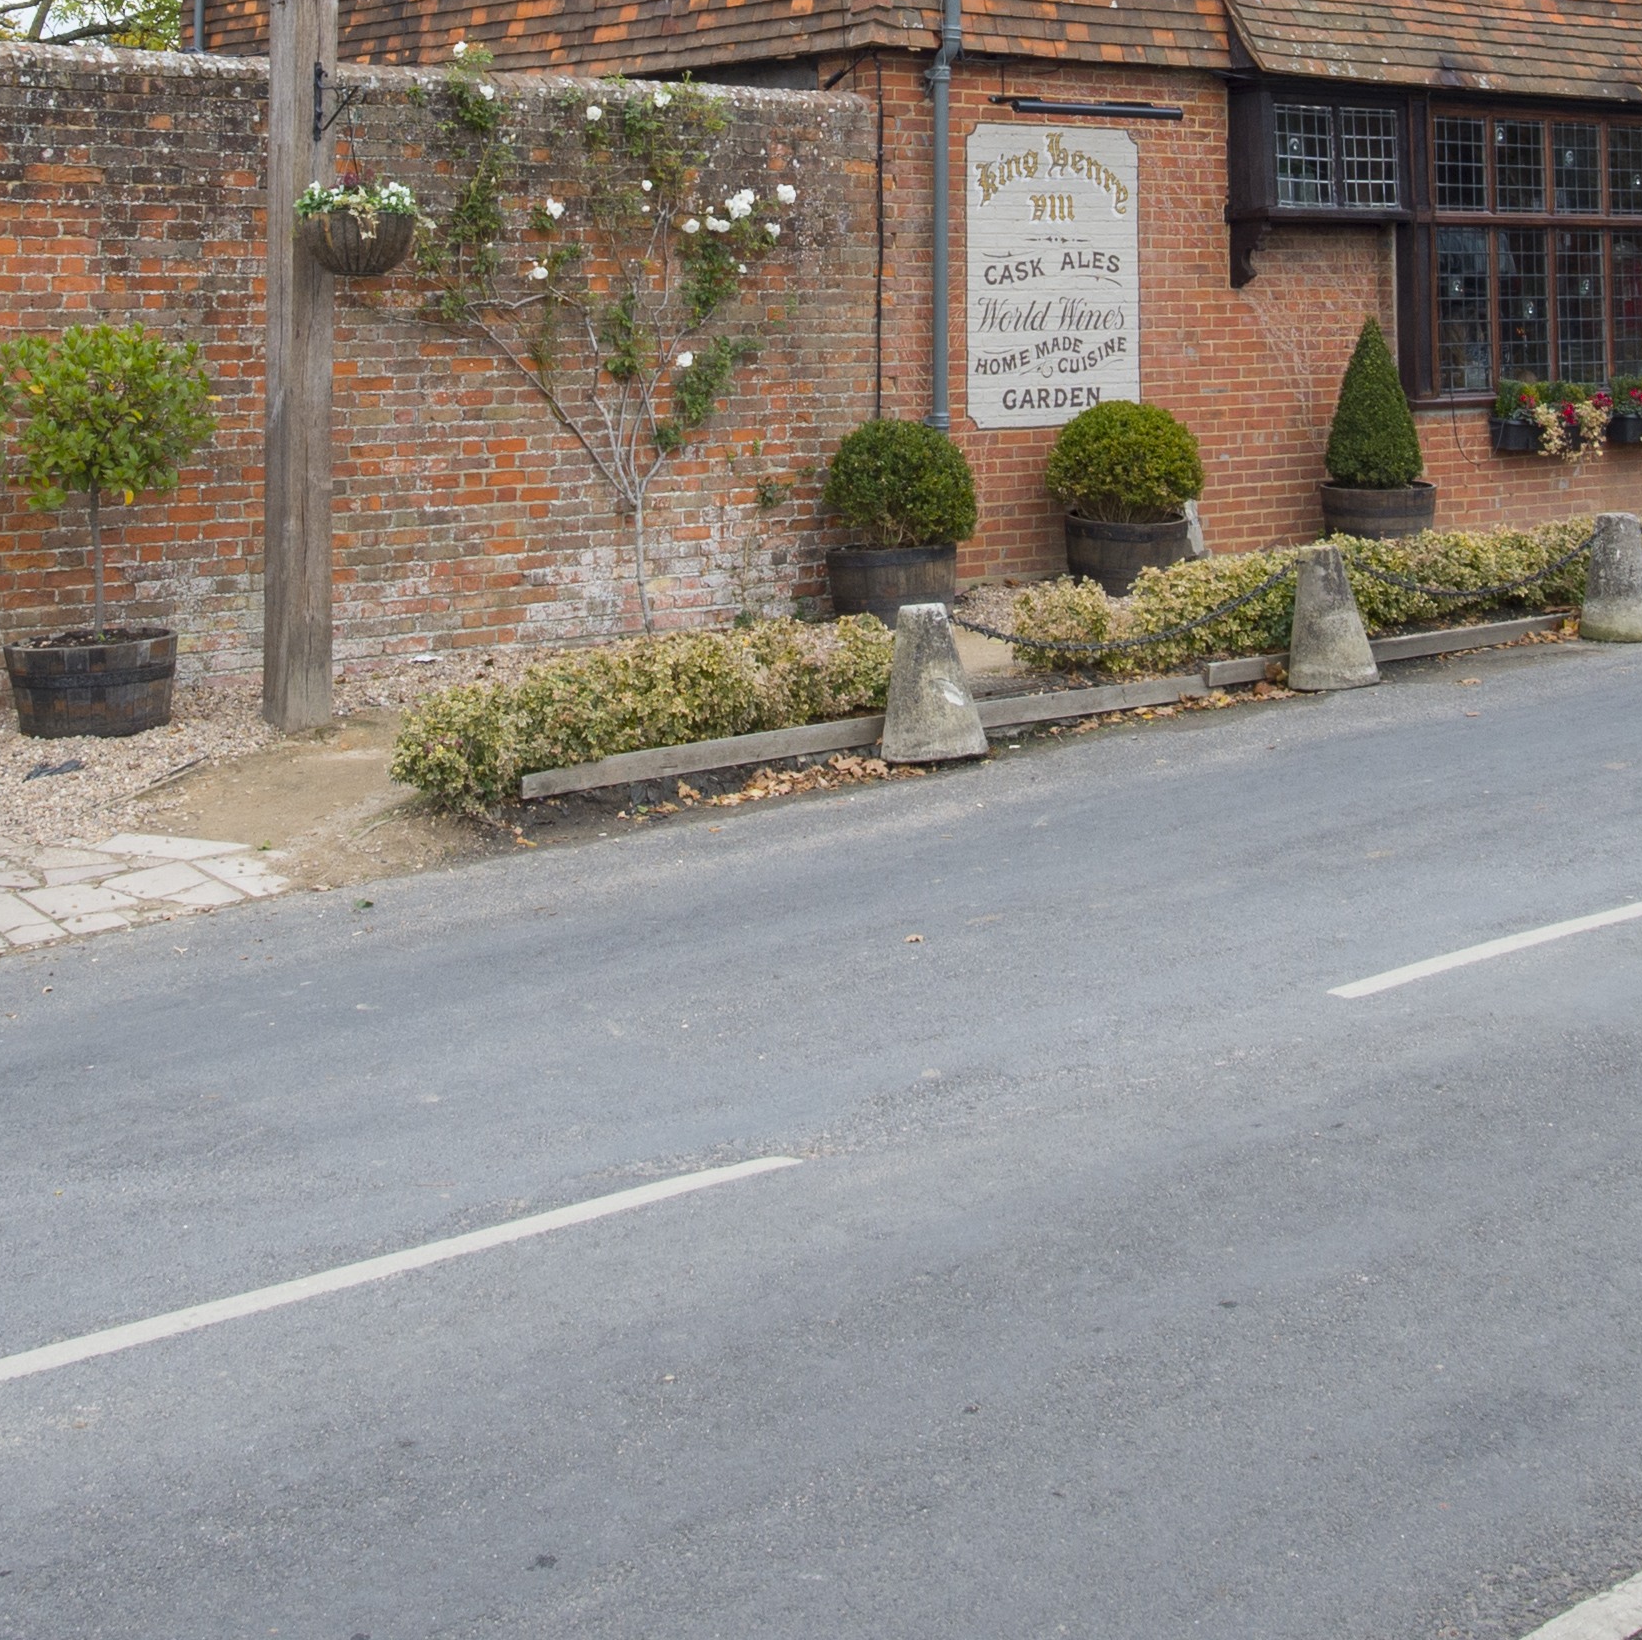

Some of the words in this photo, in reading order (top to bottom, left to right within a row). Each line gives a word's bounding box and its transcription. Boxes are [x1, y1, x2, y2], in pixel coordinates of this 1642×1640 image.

[974, 147, 1039, 208] King
[1044, 131, 1129, 215] Henry
[1029, 194, 1076, 222] VIII
[984, 257, 1046, 285] CASK
[1060, 251, 1121, 273] ALES
[977, 297, 1052, 332] World
[1057, 296, 1125, 331] Wines
[974, 349, 1031, 375] HOME
[1035, 336, 1083, 359] MADE
[1057, 336, 1127, 374] CUISINE
[1002, 387, 1101, 410] GARDEN
